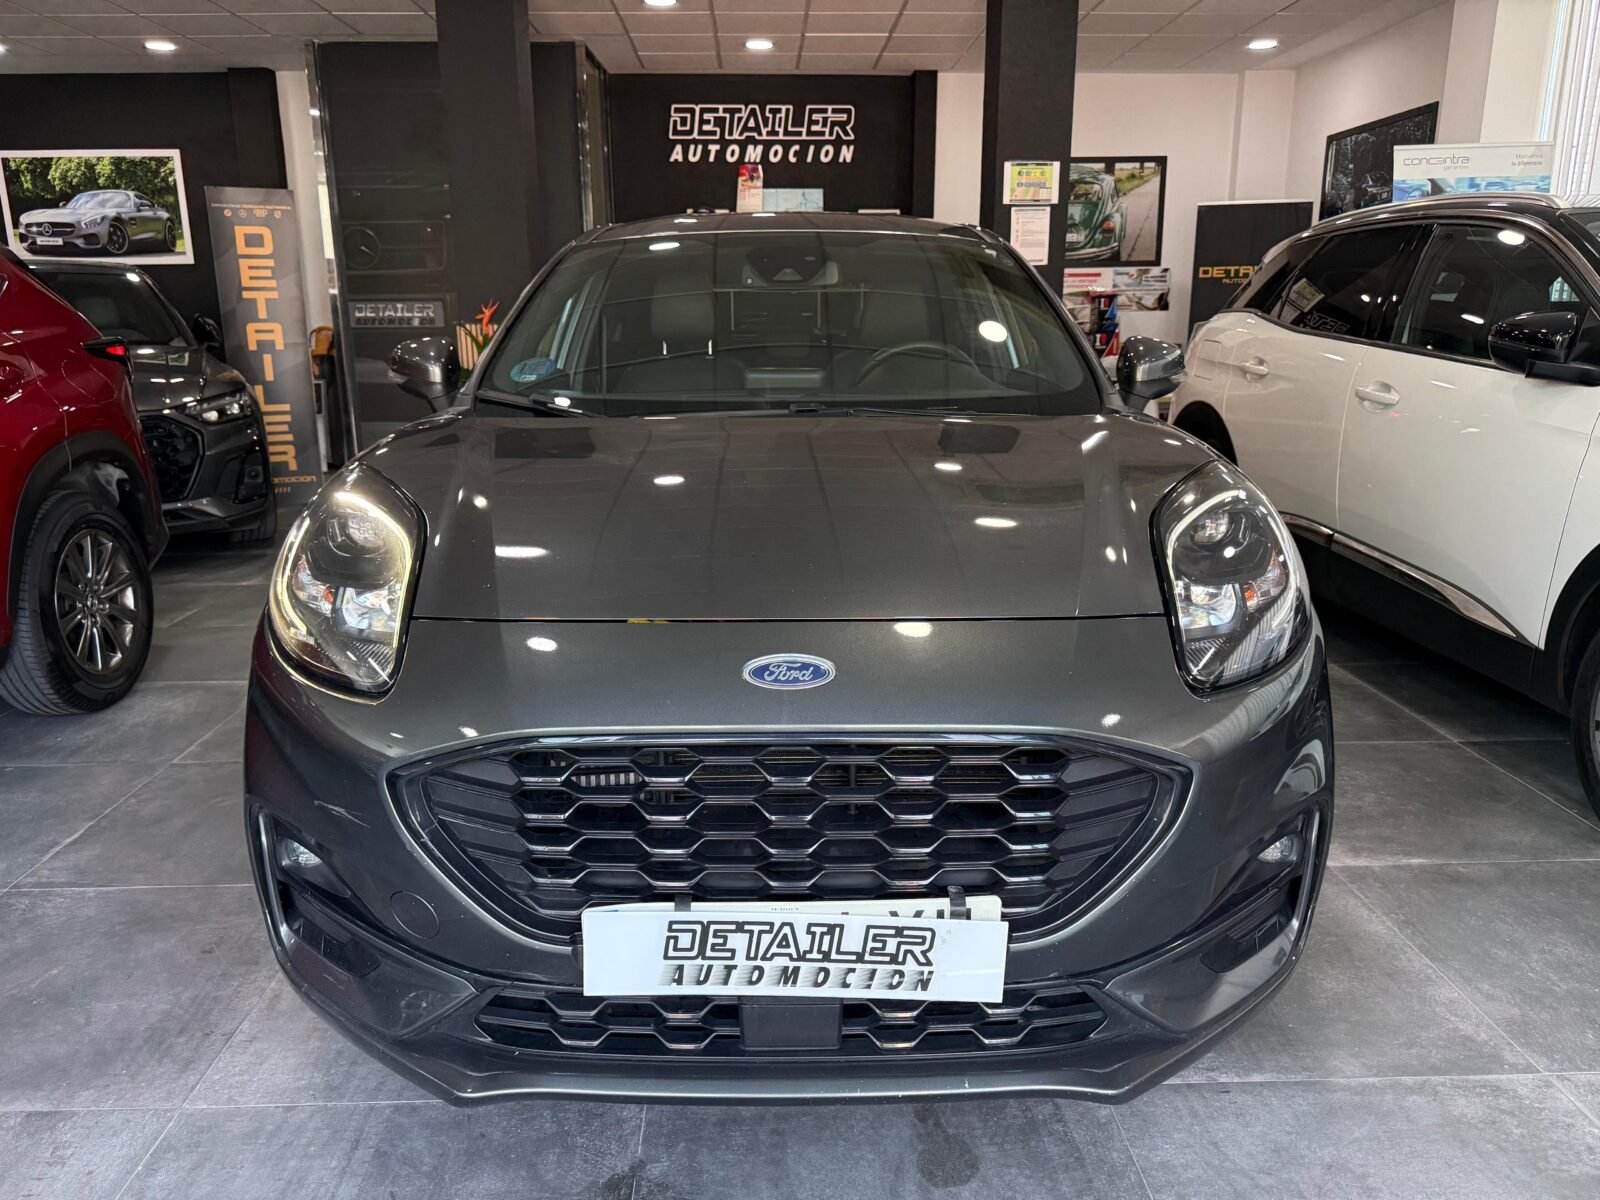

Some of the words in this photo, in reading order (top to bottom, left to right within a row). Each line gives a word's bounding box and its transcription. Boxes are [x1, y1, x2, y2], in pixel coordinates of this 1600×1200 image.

[668, 104, 855, 140] DETAILER
[668, 144, 855, 163] AUTOMOCION
[1403, 153, 1470, 166] concentra
[1199, 265, 1257, 278] DETA
[763, 662, 814, 681] Ford
[663, 920, 937, 967] DETAILER
[662, 964, 935, 992] AUTOMOCION
